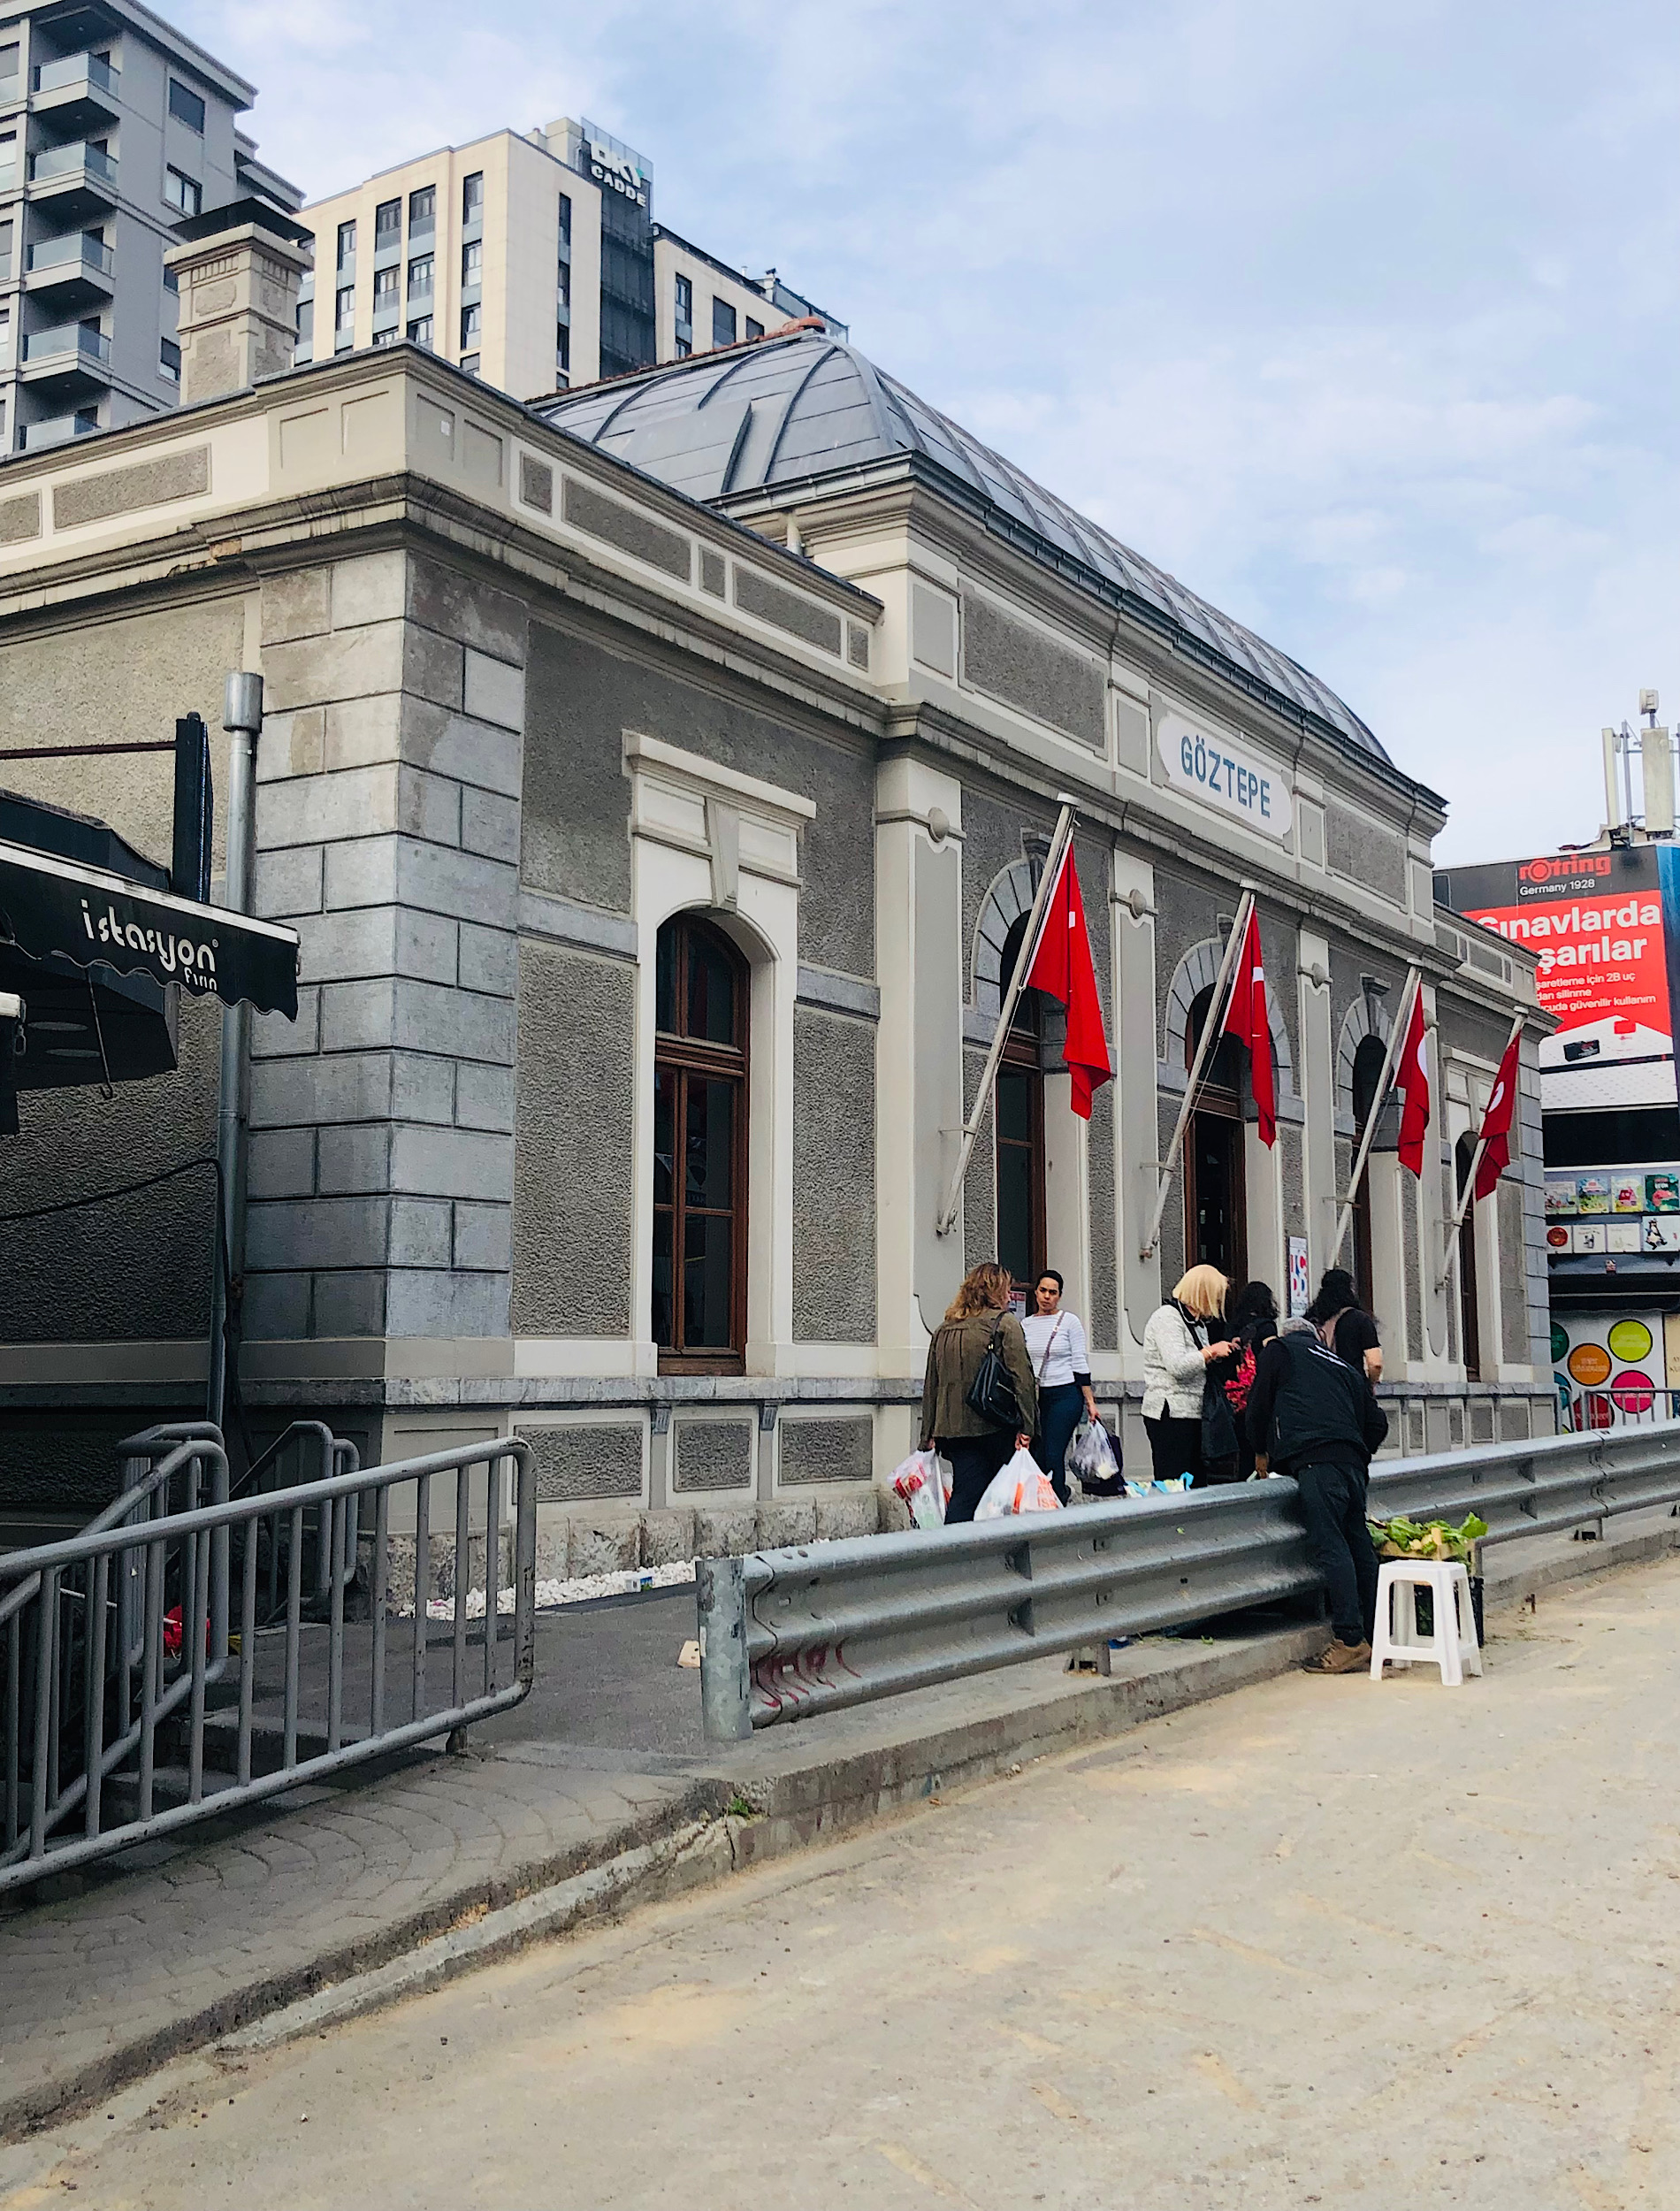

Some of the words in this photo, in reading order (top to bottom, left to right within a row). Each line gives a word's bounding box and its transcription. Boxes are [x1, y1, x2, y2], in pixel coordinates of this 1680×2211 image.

[591, 164, 646, 207] CADDE
[1180, 735, 1271, 819] GÖZTEPE
[1518, 853, 1611, 883] rotring
[1519, 884, 1567, 896] Germany
[1569, 878, 1595, 890] 1928
[1586, 975, 1605, 985] için
[1606, 972, 1621, 983] 2B
[1623, 973, 1636, 982] uç
[1569, 998, 1612, 1012] güvenilir
[1614, 995, 1656, 1006] kullanım
